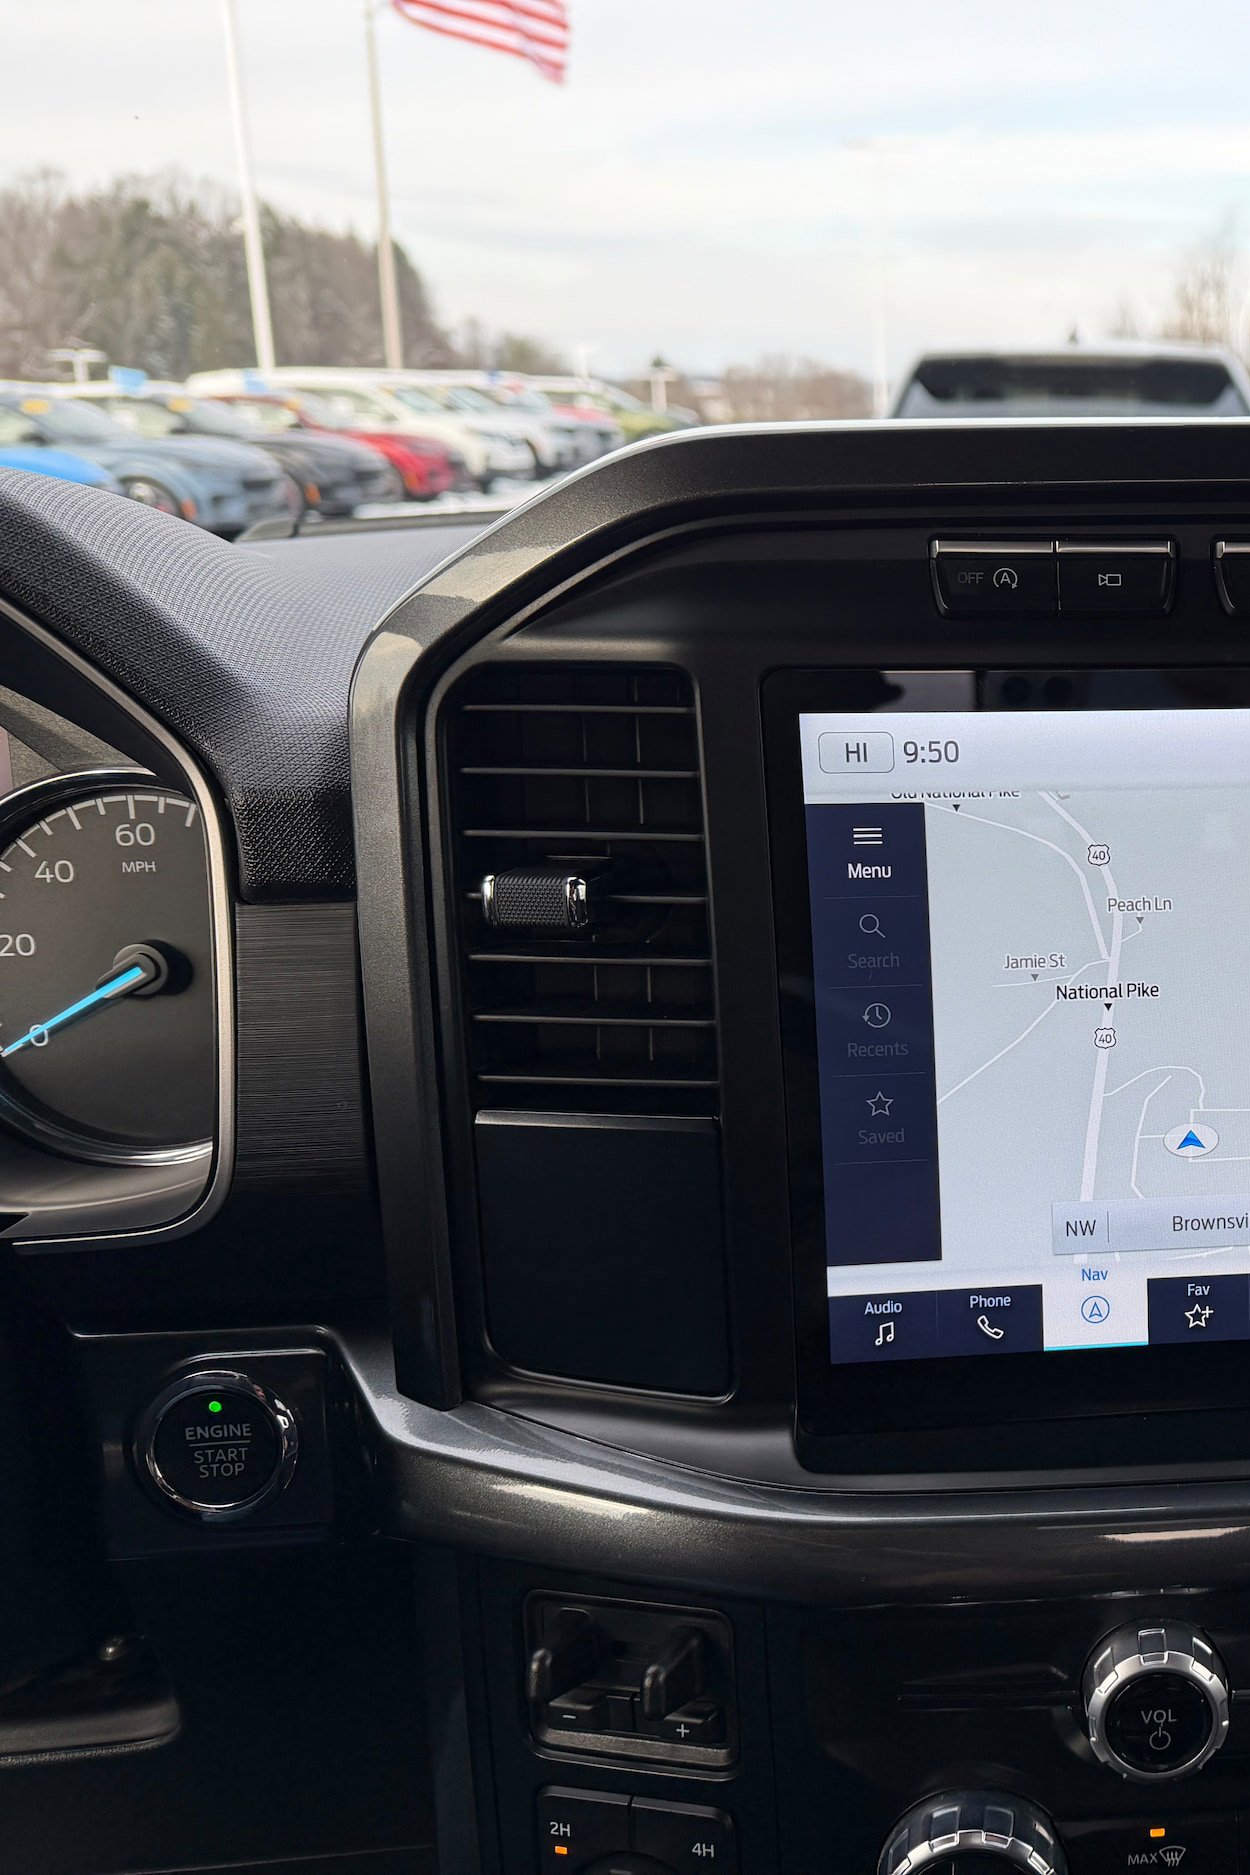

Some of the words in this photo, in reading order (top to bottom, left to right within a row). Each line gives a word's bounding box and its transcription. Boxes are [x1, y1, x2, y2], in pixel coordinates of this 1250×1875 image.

[845, 742, 868, 763] HI
[903, 740, 960, 764] 9:50
[115, 822, 155, 847] 60
[1092, 850, 1106, 861] 40
[34, 859, 75, 883] 40
[121, 860, 156, 873] MPH
[847, 862, 892, 879] Menu
[1107, 896, 1152, 912] Peach
[1154, 896, 1172, 911] Ln
[0, 933, 36, 957] 20
[847, 952, 900, 969] Search
[1003, 954, 1046, 970] Jamie
[1047, 953, 1066, 969] St
[1056, 983, 1123, 1000] National
[1126, 982, 1159, 998] Pike
[1098, 1033, 1112, 1044] 40
[847, 1041, 909, 1058] Recents
[858, 1127, 905, 1145] Saved
[1066, 1219, 1097, 1237] NW
[1081, 1268, 1109, 1282] Nav
[1187, 1283, 1211, 1297] Fav
[864, 1300, 903, 1315] Audio
[969, 1294, 1012, 1309] Phone
[185, 1423, 252, 1441] ENGINE
[193, 1447, 249, 1464] START
[198, 1462, 245, 1479] STOP
[1140, 1708, 1178, 1725] VOL
[549, 1821, 571, 1837] 2H
[691, 1842, 715, 1858] 4H
[1127, 1852, 1158, 1866] MAX
